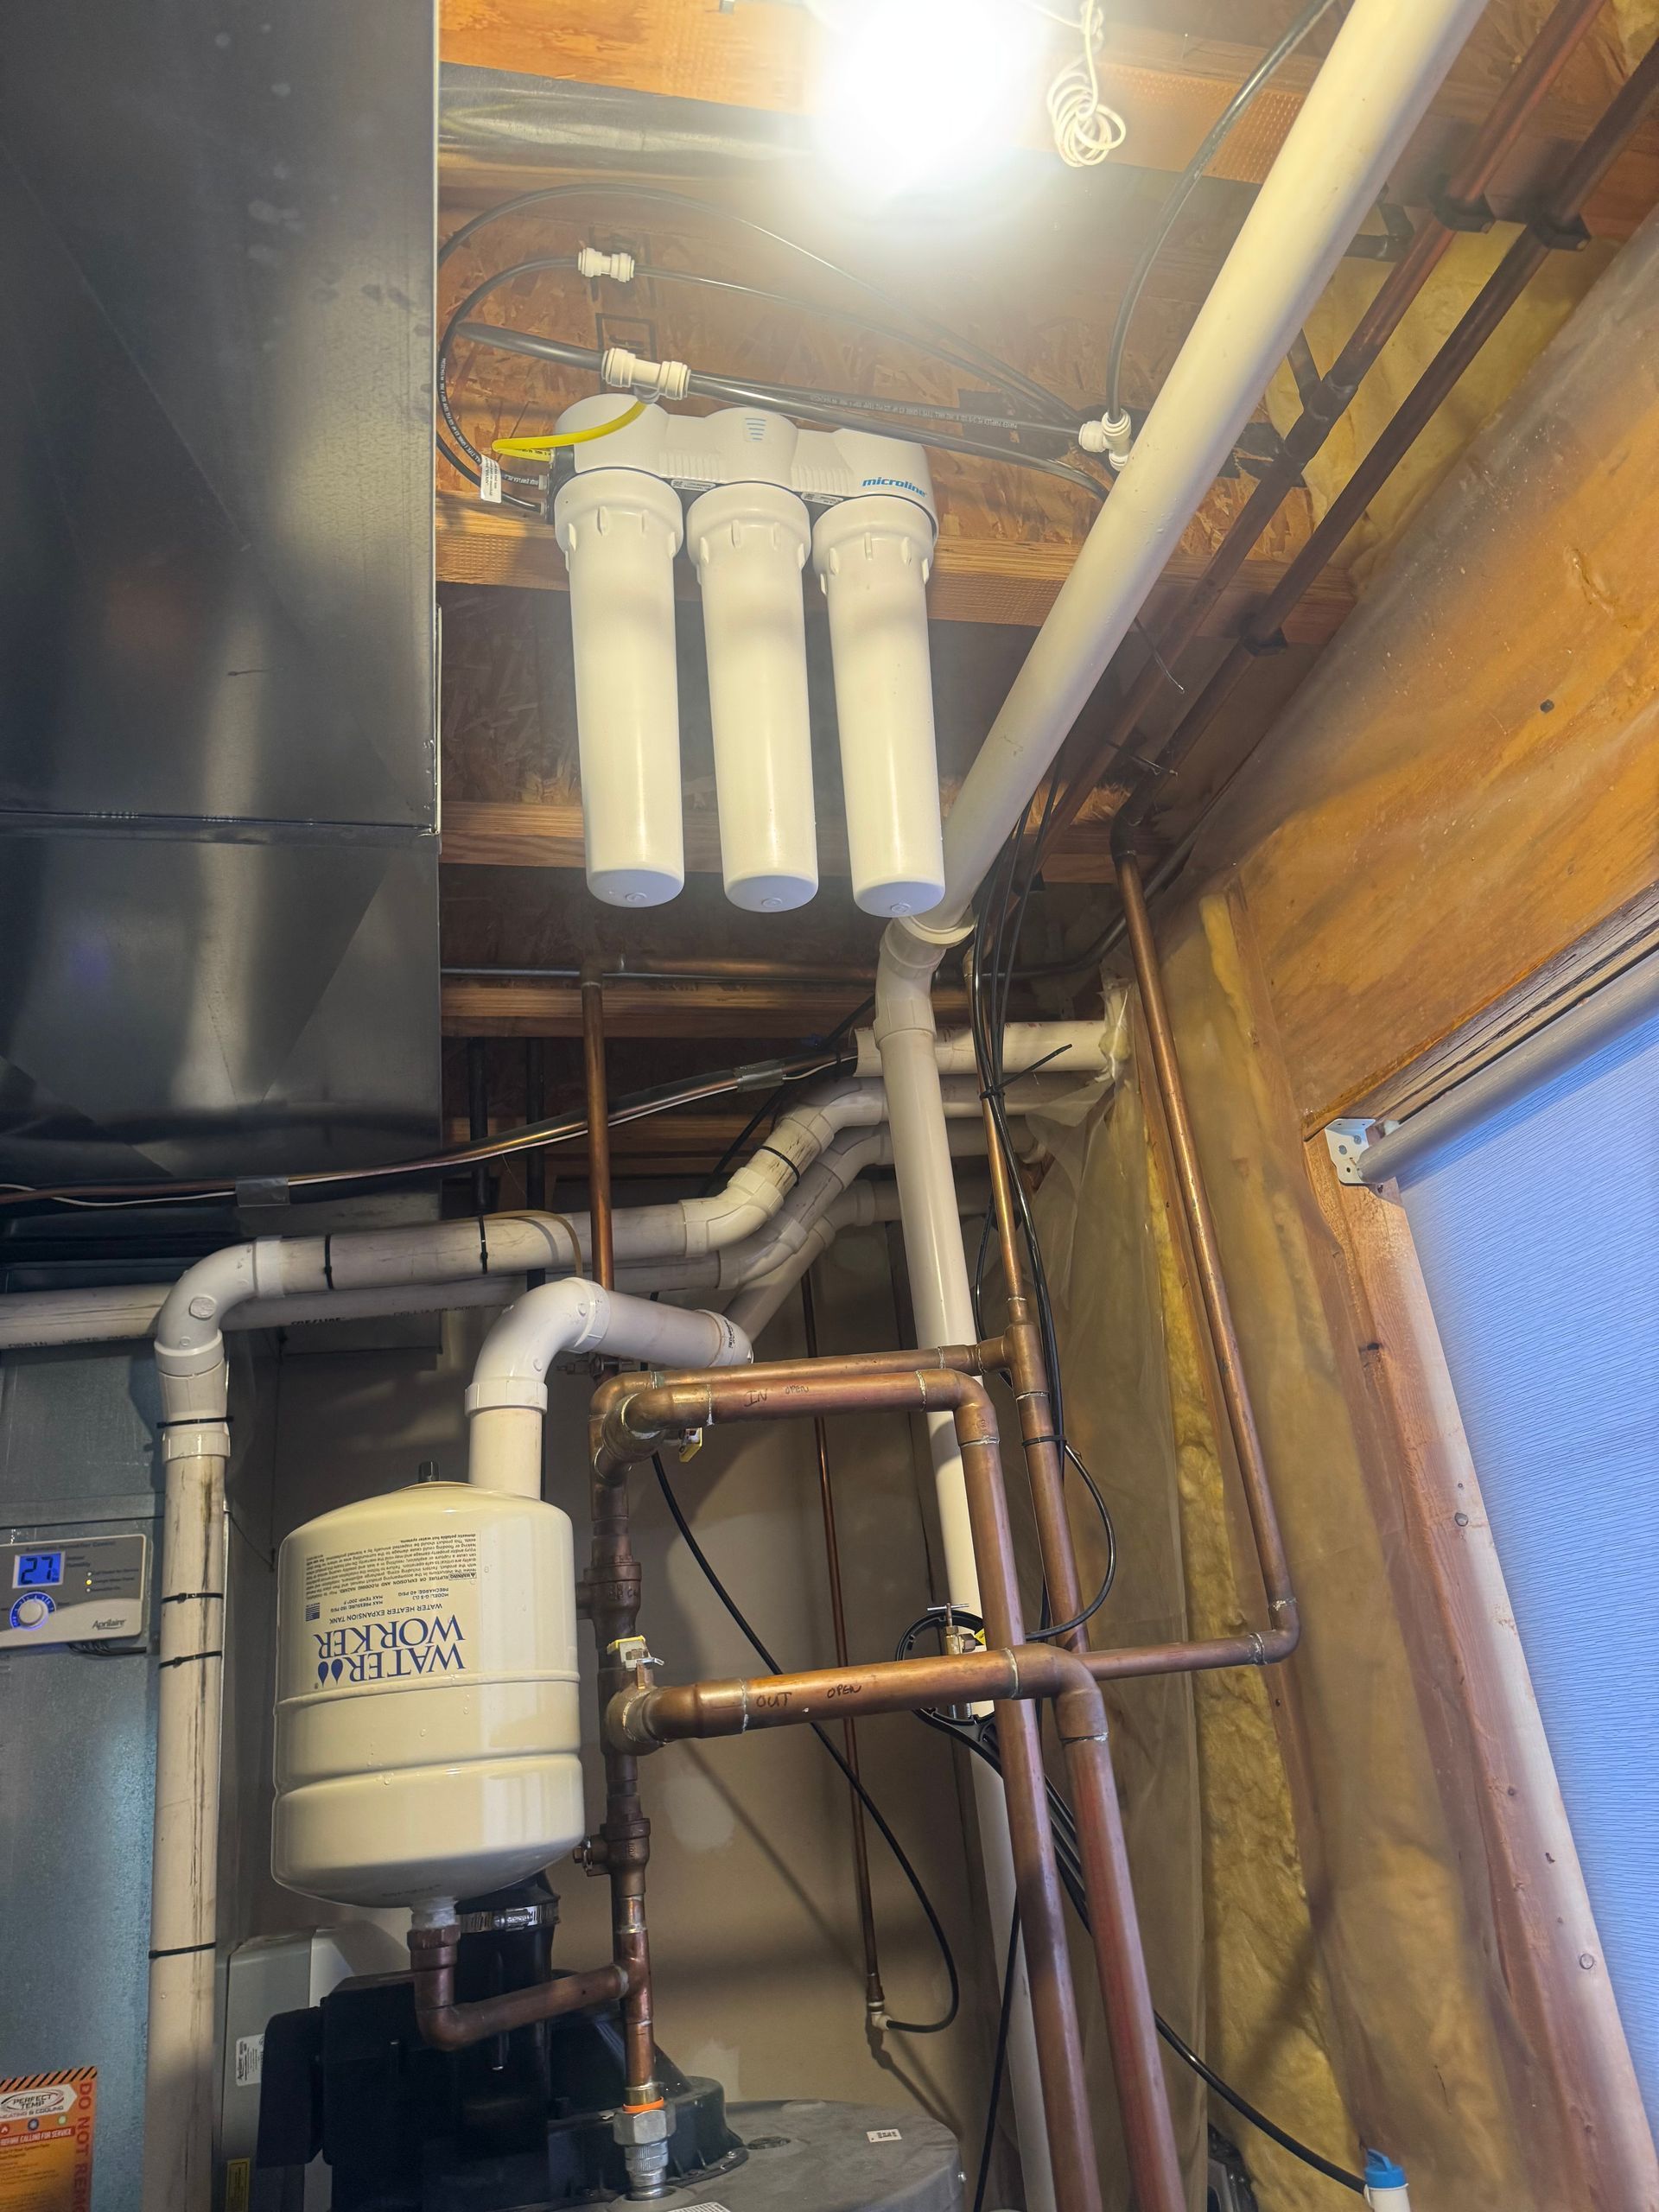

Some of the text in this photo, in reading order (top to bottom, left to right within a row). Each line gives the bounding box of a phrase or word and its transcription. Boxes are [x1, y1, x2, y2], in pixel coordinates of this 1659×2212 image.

[862, 477, 925, 497] microline
[744, 1389, 768, 1407] IN
[21, 1557, 53, 1584] 27
[92, 1618, 126, 1630] Aprilaire
[329, 1603, 442, 1624] WATER HEATER EXPANSION TANK
[313, 1614, 466, 1659] WORKER
[342, 1643, 467, 1682] WATER
[756, 1684, 861, 1707] OUT OPEN
[13, 2094, 52, 2105] PERFECT
[21, 2101, 45, 2110] TEMP
[79, 2082, 92, 2109] DO
[76, 2117, 91, 2157] NOT
